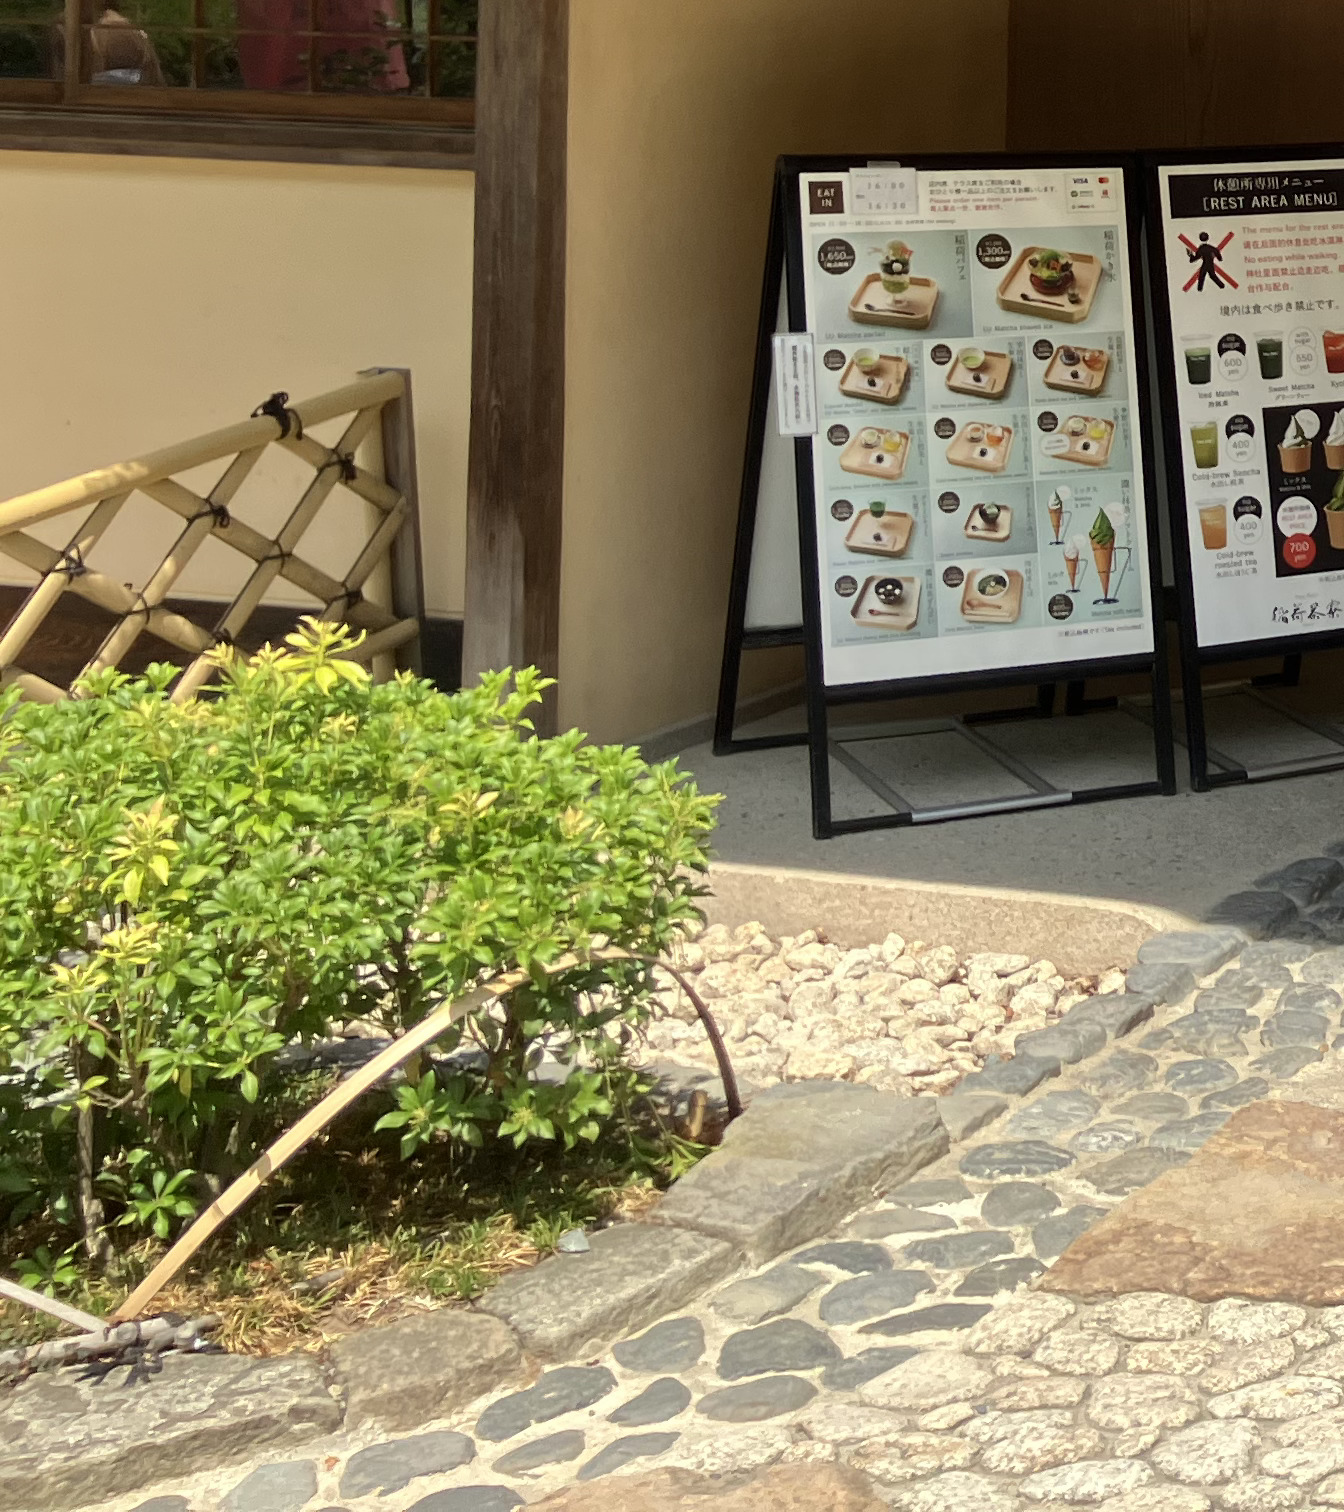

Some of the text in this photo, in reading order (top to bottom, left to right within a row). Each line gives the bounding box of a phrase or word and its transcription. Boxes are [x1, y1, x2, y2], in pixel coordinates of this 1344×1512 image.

[1213, 176, 1324, 192] 休憩所専用メニュー
[817, 188, 835, 198] EAT
[821, 199, 833, 208] IN
[1251, 194, 1289, 209] AREA
[1242, 226, 1257, 234] The
[1259, 226, 1283, 234] menu
[1285, 224, 1297, 232] for
[1299, 224, 1311, 232] the
[1243, 256, 1256, 264] No
[1258, 254, 1283, 263] eating
[1285, 252, 1305, 261] while
[1219, 299, 1340, 317] 境内は食べ歩き禁止です。
[1224, 358, 1243, 368] 600
[1268, 383, 1315, 393] Sweet Matcha
[1216, 390, 1240, 398] Matcha
[1232, 440, 1250, 450] 400
[1192, 468, 1261, 482] Cold-brew Sencha
[1239, 521, 1258, 531] 400
[1289, 541, 1310, 553] 700
[1216, 549, 1254, 560] Cold-brew
[1214, 559, 1258, 569] roasted tea
